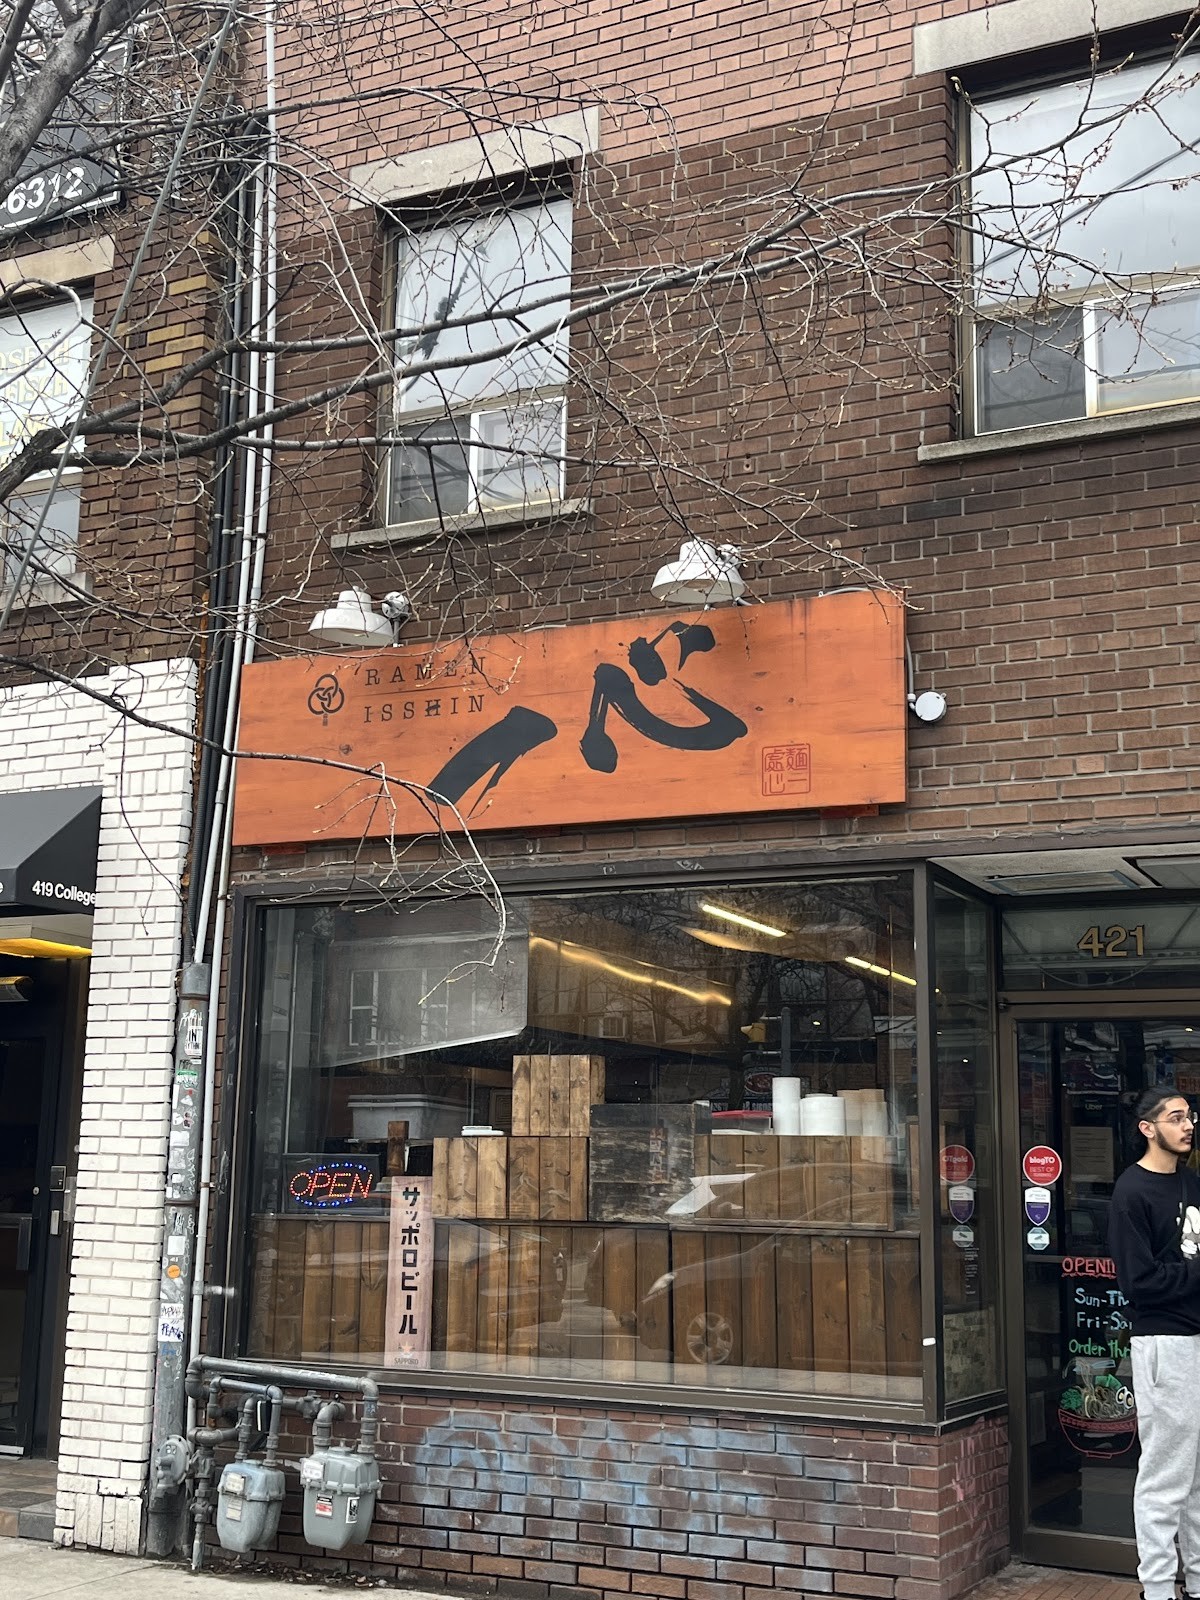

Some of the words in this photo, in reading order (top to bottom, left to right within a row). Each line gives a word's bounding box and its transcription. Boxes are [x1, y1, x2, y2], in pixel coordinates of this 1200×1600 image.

[364, 656, 486, 686] RAMEN
[363, 694, 485, 724] ISSHIN
[32, 880, 53, 897] 419
[54, 883, 96, 906] College
[1077, 924, 1145, 957] 421
[1029, 1157, 1055, 1165] blogTO
[290, 1172, 373, 1198] OPEN
[399, 1187, 420, 1334] サッポロビール
[1069, 1337, 1106, 1356] Order
